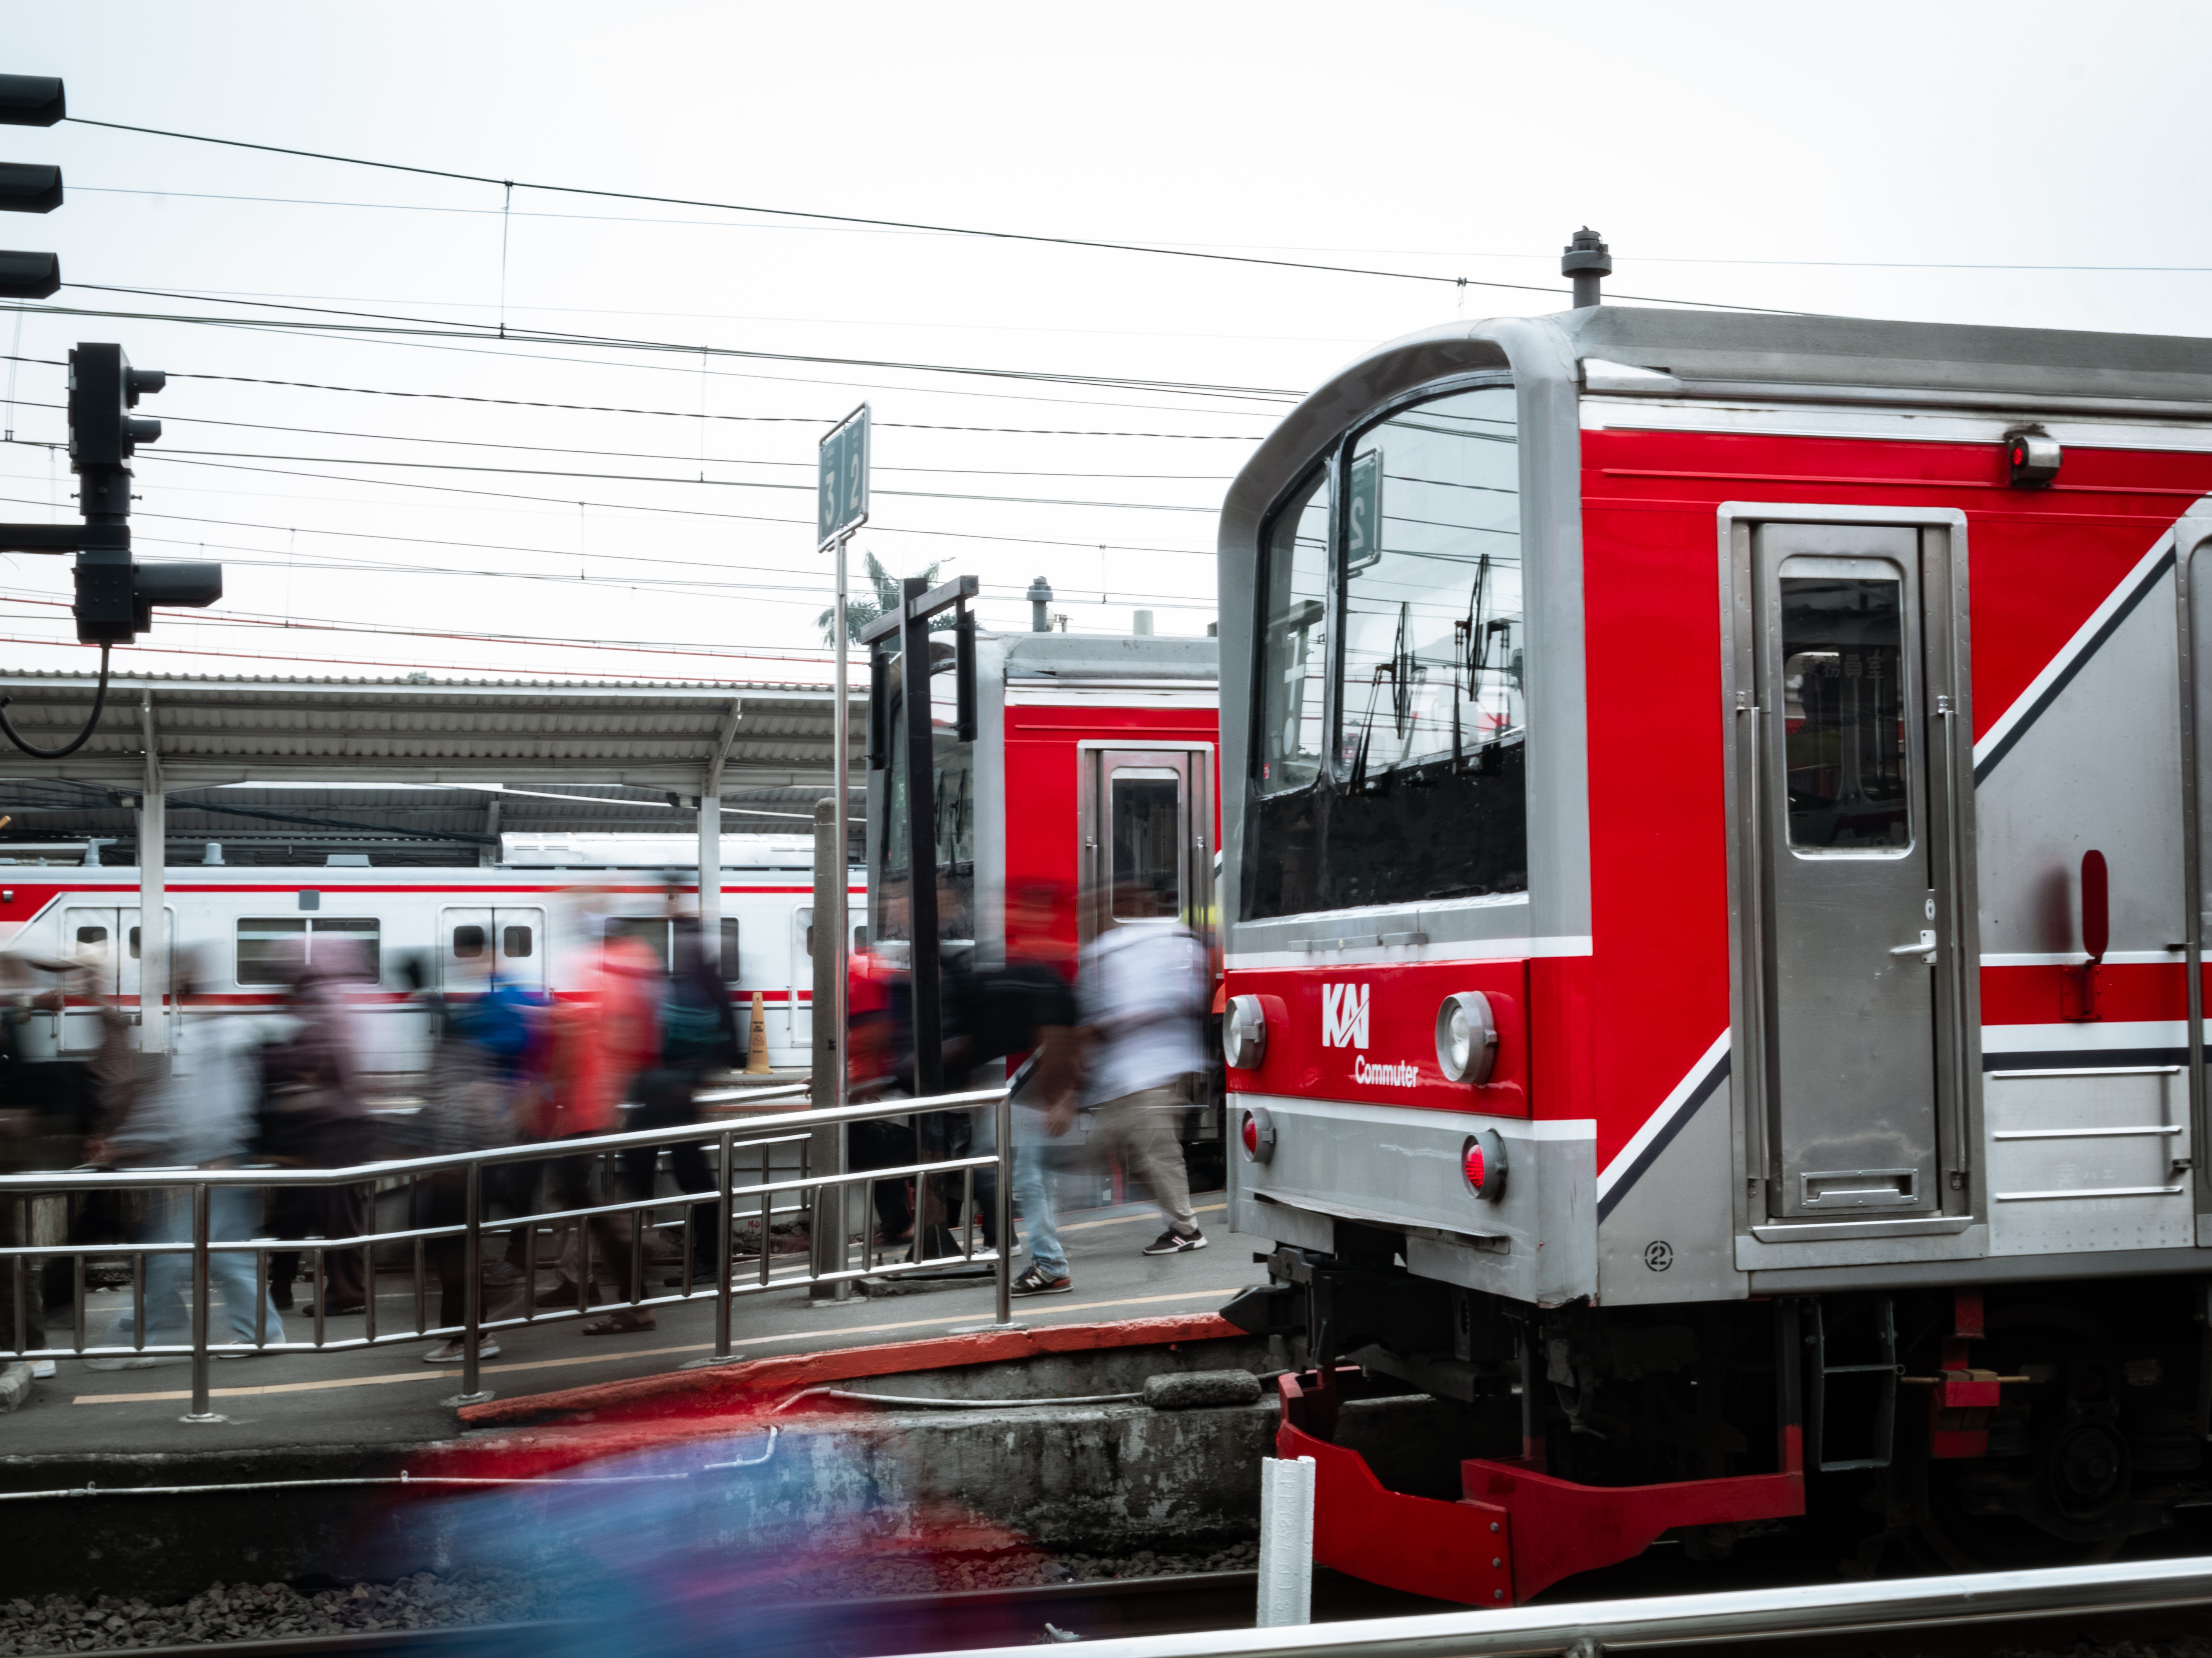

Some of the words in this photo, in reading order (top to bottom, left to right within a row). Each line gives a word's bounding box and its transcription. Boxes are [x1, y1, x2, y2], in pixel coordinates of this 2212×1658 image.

[825, 471, 835, 525] 3
[850, 453, 859, 510] 2
[1322, 983, 1369, 1049] KAI
[1355, 1055, 1418, 1088] Commuter
[1651, 1246, 1666, 1265] 2
[1026, 1275, 1042, 1288] N
